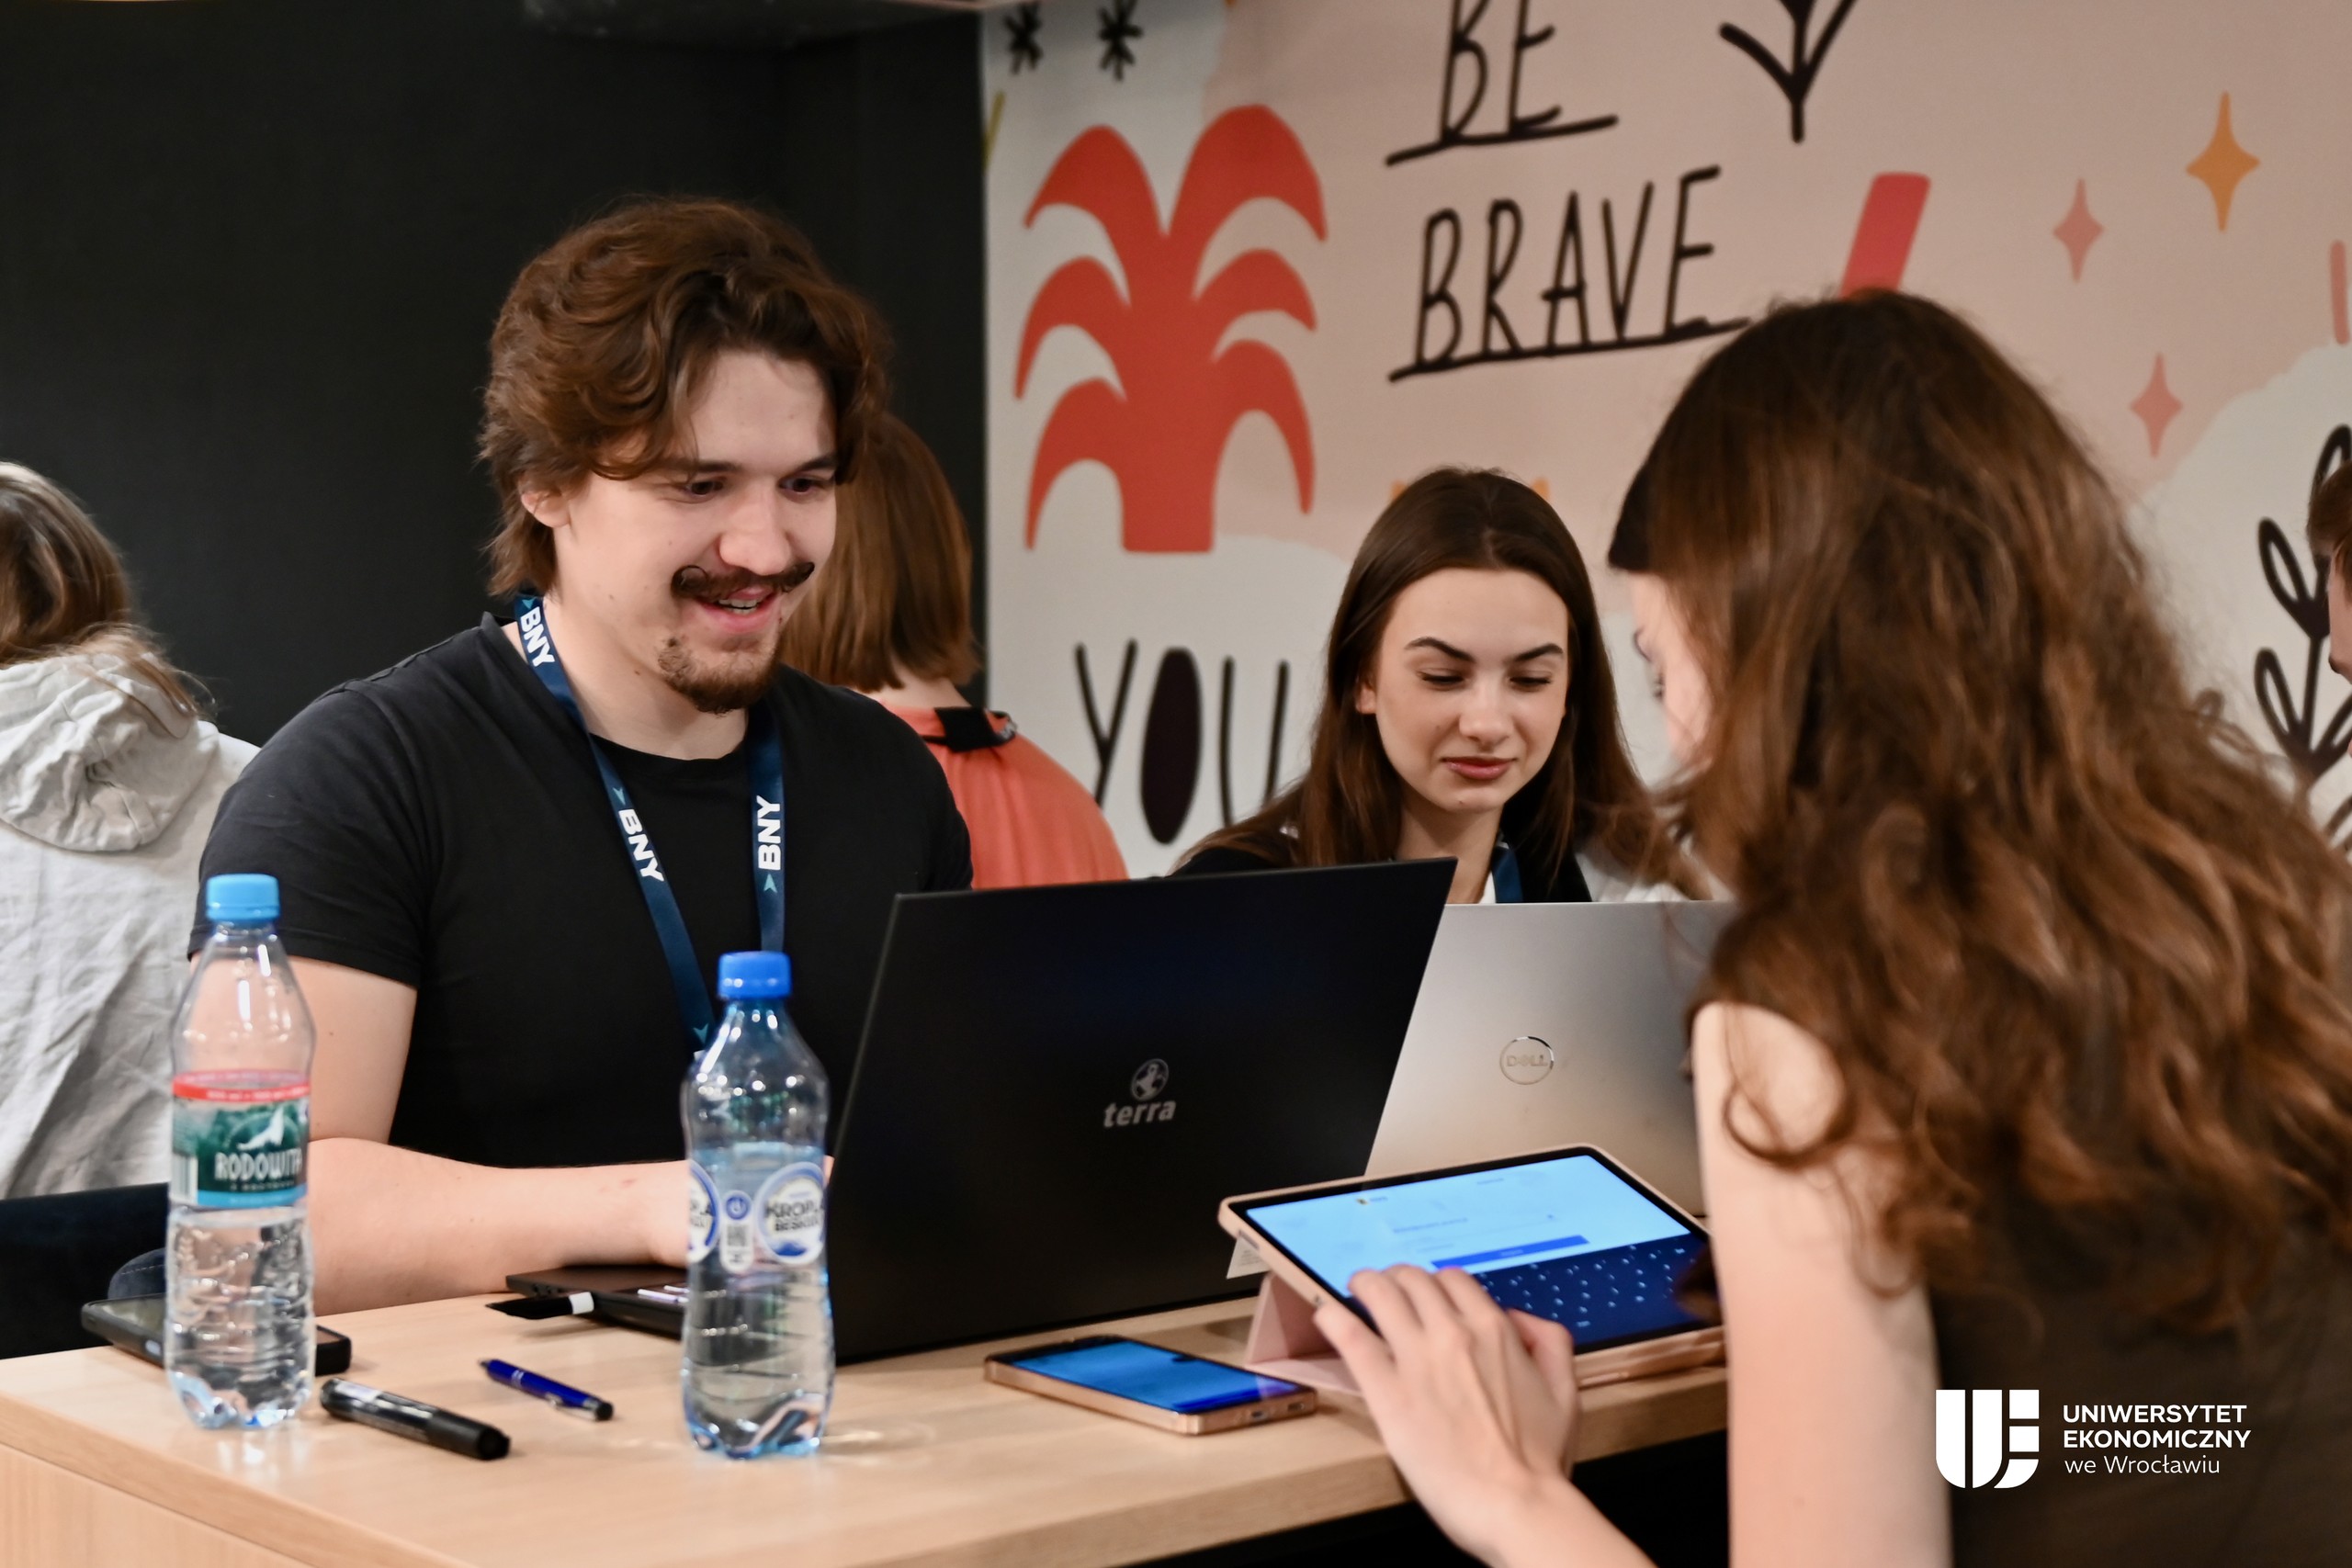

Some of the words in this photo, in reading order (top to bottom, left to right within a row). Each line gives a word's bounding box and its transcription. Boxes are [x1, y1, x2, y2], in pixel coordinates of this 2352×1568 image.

[1435, 0, 1564, 145] BE
[1415, 165, 1722, 370] BRAVE
[519, 605, 556, 668] BNY
[1073, 637, 1290, 845] YOU
[617, 808, 664, 882] BNY
[755, 795, 782, 871] BNY
[1506, 1054, 1549, 1067] DELL
[1103, 1100, 1177, 1128] terra
